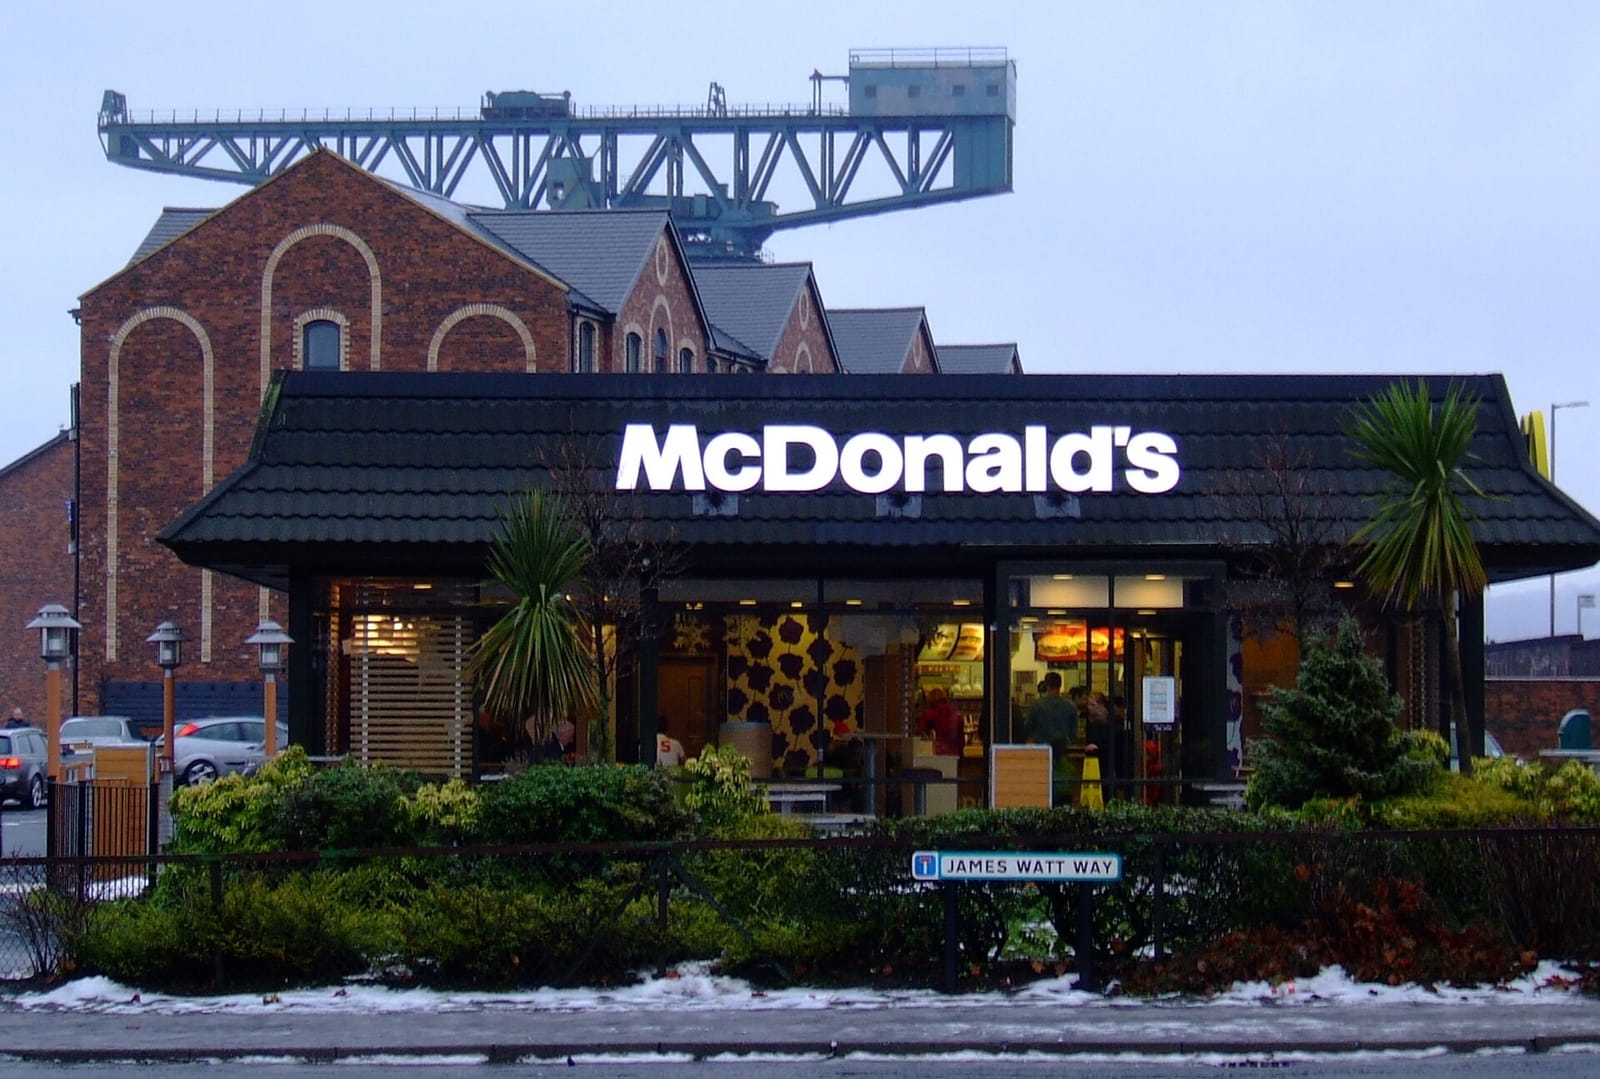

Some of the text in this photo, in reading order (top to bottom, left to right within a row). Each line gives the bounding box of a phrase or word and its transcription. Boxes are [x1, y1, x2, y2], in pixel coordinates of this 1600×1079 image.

[615, 423, 1181, 494] McDonald's
[947, 859, 1112, 874] JAMES WATT WAY
